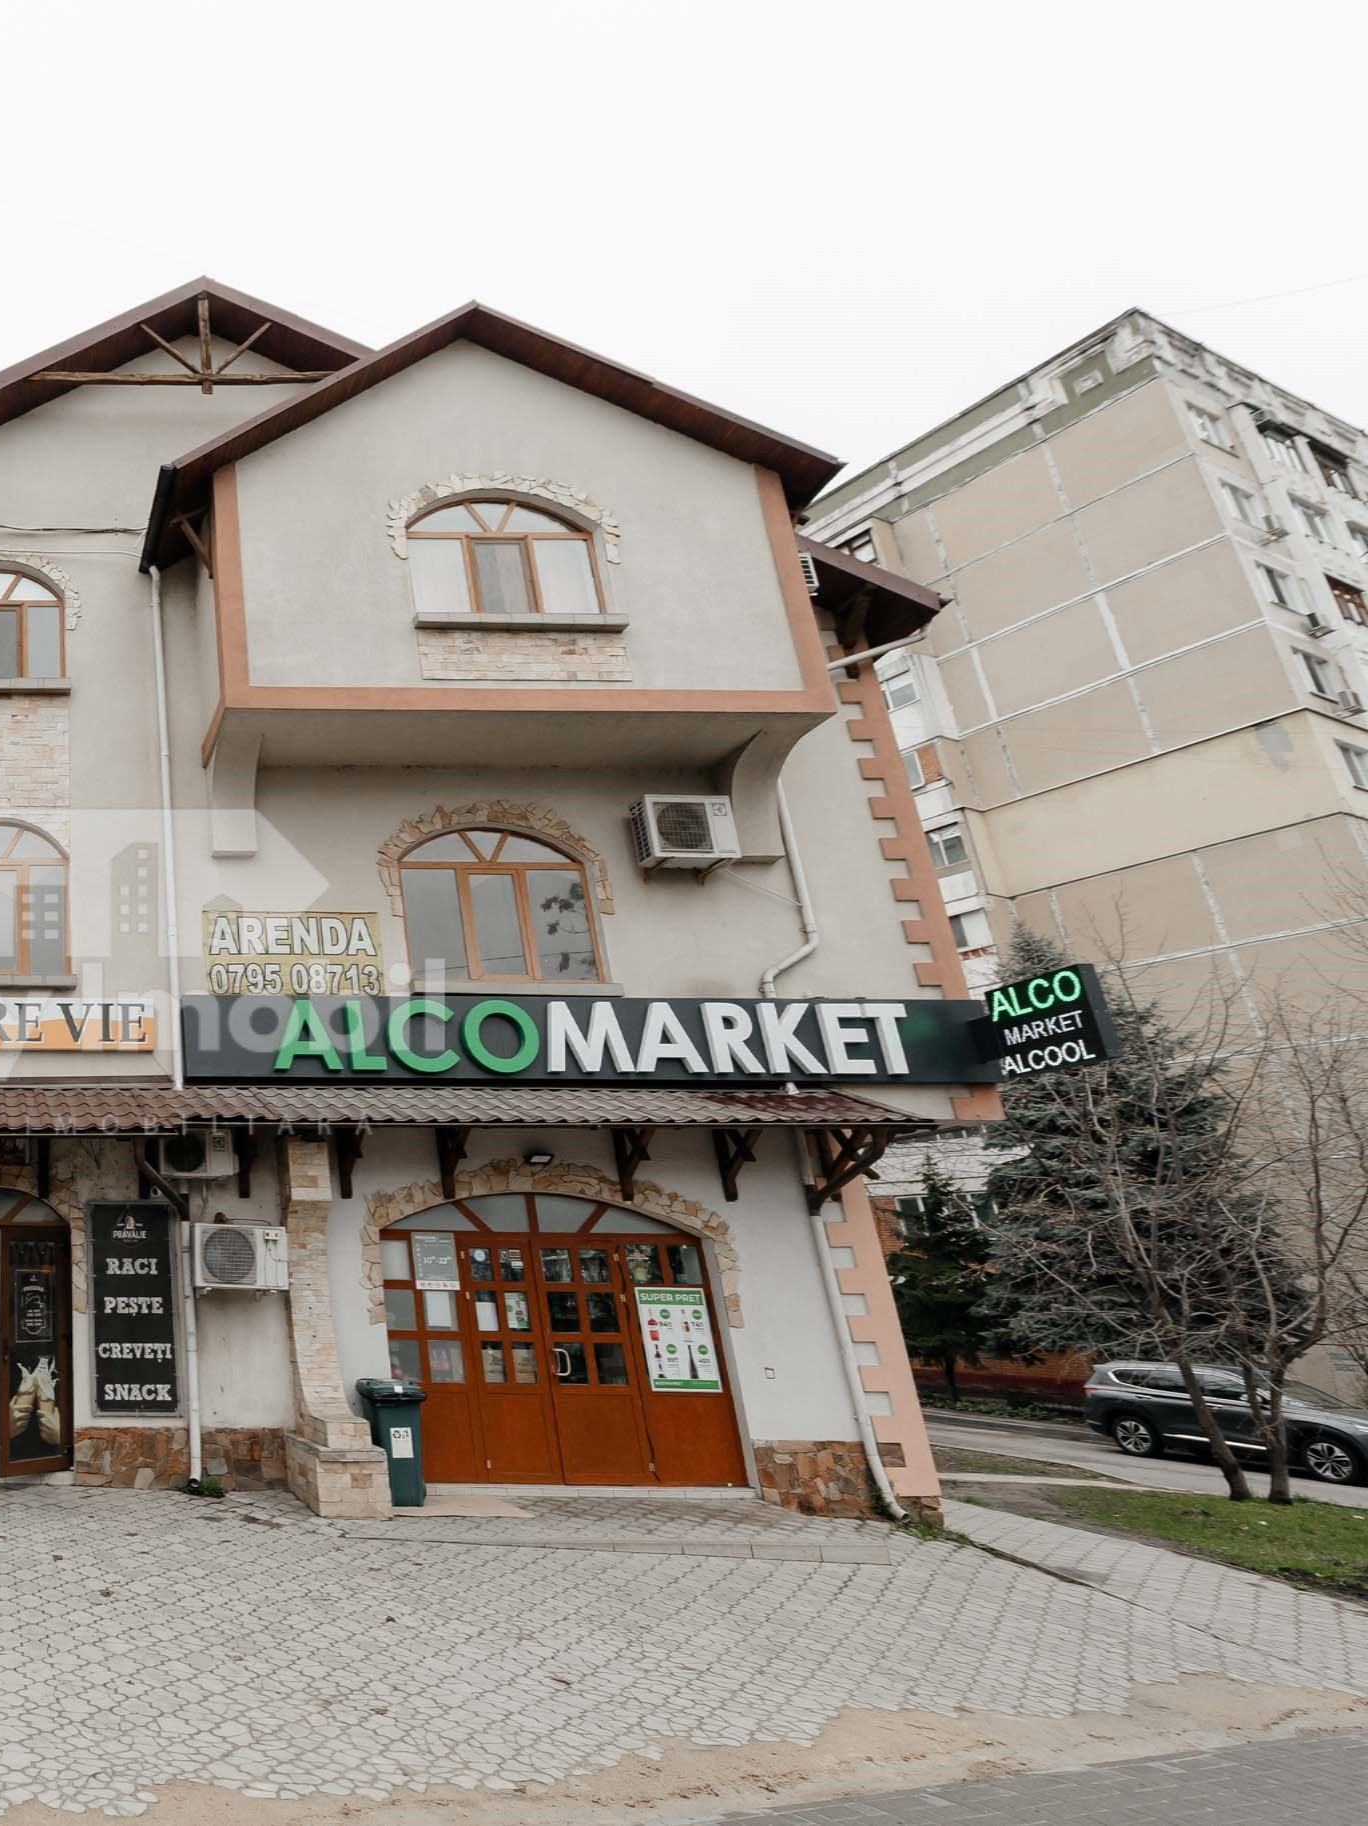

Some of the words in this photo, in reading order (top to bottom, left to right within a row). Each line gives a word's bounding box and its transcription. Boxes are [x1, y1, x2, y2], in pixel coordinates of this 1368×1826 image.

[209, 916, 378, 957] ARENDA
[209, 962, 283, 995] 0795
[289, 962, 382, 996] 08713
[992, 970, 1081, 1022] ALCO
[56, 1001, 149, 1046] VIE
[1003, 1009, 1083, 1046] MARKET
[1001, 1039, 1096, 1076] ALCOOL
[106, 1258, 158, 1275] RACI
[640, 1293, 673, 1302] SUPER
[104, 1384, 172, 1401] SNACK
